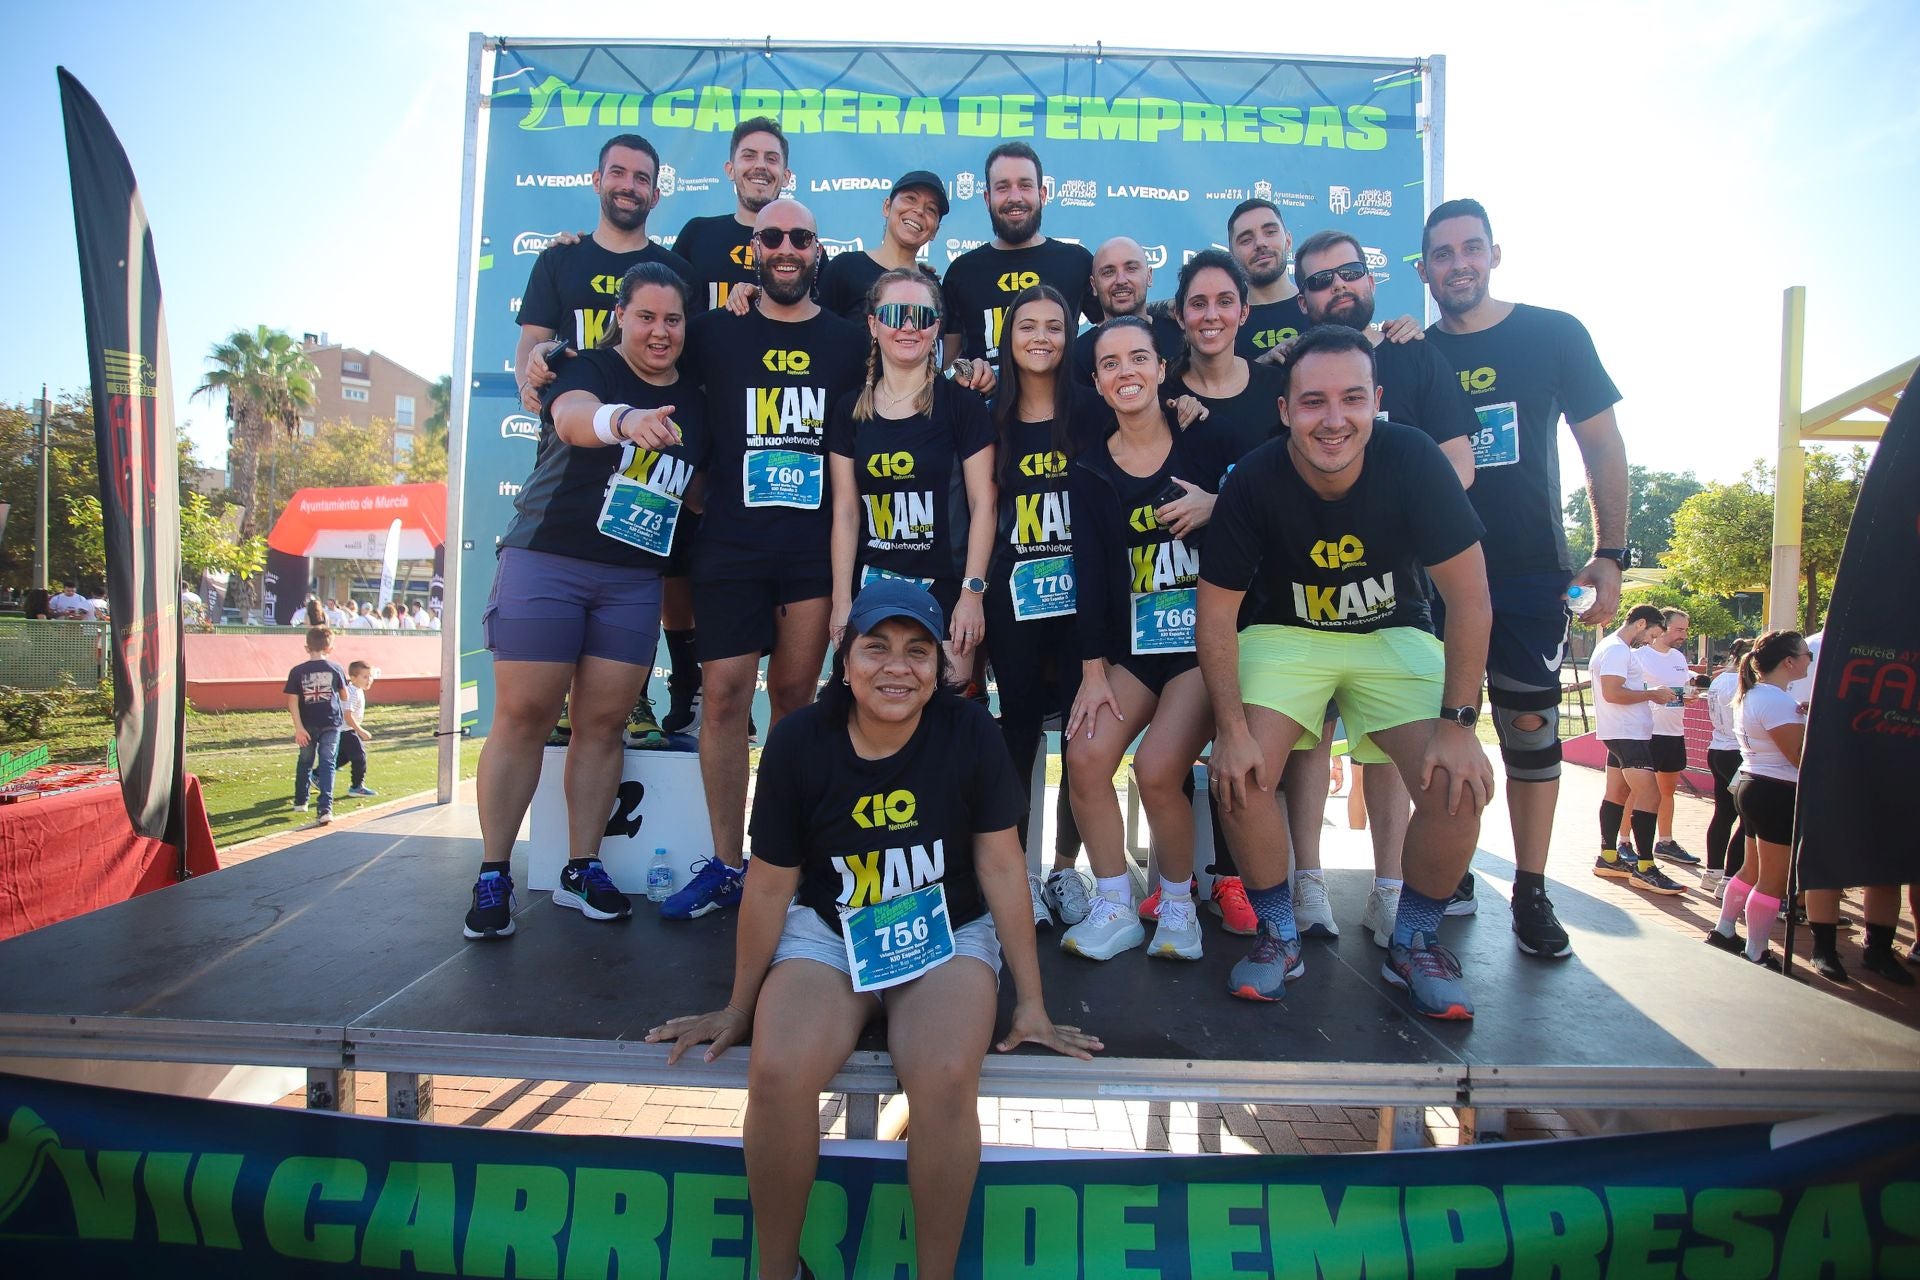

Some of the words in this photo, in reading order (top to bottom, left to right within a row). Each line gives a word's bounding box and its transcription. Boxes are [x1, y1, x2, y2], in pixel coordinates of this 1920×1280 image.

[562, 91, 643, 127] VII
[652, 86, 946, 136] CARRERA
[957, 94, 1036, 139] DE
[1045, 94, 1389, 152] EMPRESAS
[516, 174, 538, 187] LA
[538, 174, 593, 188] VERDAD
[811, 179, 830, 192] LA
[831, 178, 893, 191] VERDAD
[1057, 190, 1097, 199] ATLETISMO
[1107, 186, 1128, 199] LA
[1129, 187, 1190, 202] VERDAD
[1274, 191, 1316, 201] Ayuntamiento
[1353, 200, 1392, 208] ATLETISMO
[762, 349, 811, 372] KIO
[746, 386, 826, 435] IKAN
[802, 418, 825, 429] SPORT
[746, 435, 764, 447] with
[619, 443, 694, 497] IKAN
[866, 451, 915, 478] KIO
[1018, 450, 1068, 477] KIO
[765, 466, 805, 486] 760
[299, 499, 360, 515] Ayuntamiento
[360, 497, 373, 509] de
[374, 495, 409, 508] Murcia
[861, 490, 935, 541] IKAN
[628, 504, 664, 531] 773
[910, 524, 934, 534] SPORT
[1309, 534, 1365, 569] KIO
[1033, 574, 1073, 595] 770
[1291, 571, 1397, 621] IKAN
[1153, 608, 1196, 628] 766
[1849, 646, 1895, 660] murcia
[603, 780, 645, 839] 2
[851, 789, 917, 829] KIO
[888, 820, 919, 832] Networks
[830, 838, 945, 908] IKAN
[875, 916, 929, 952] 756
[47, 1148, 244, 1251] VII
[983, 1183, 1161, 1280] DE
